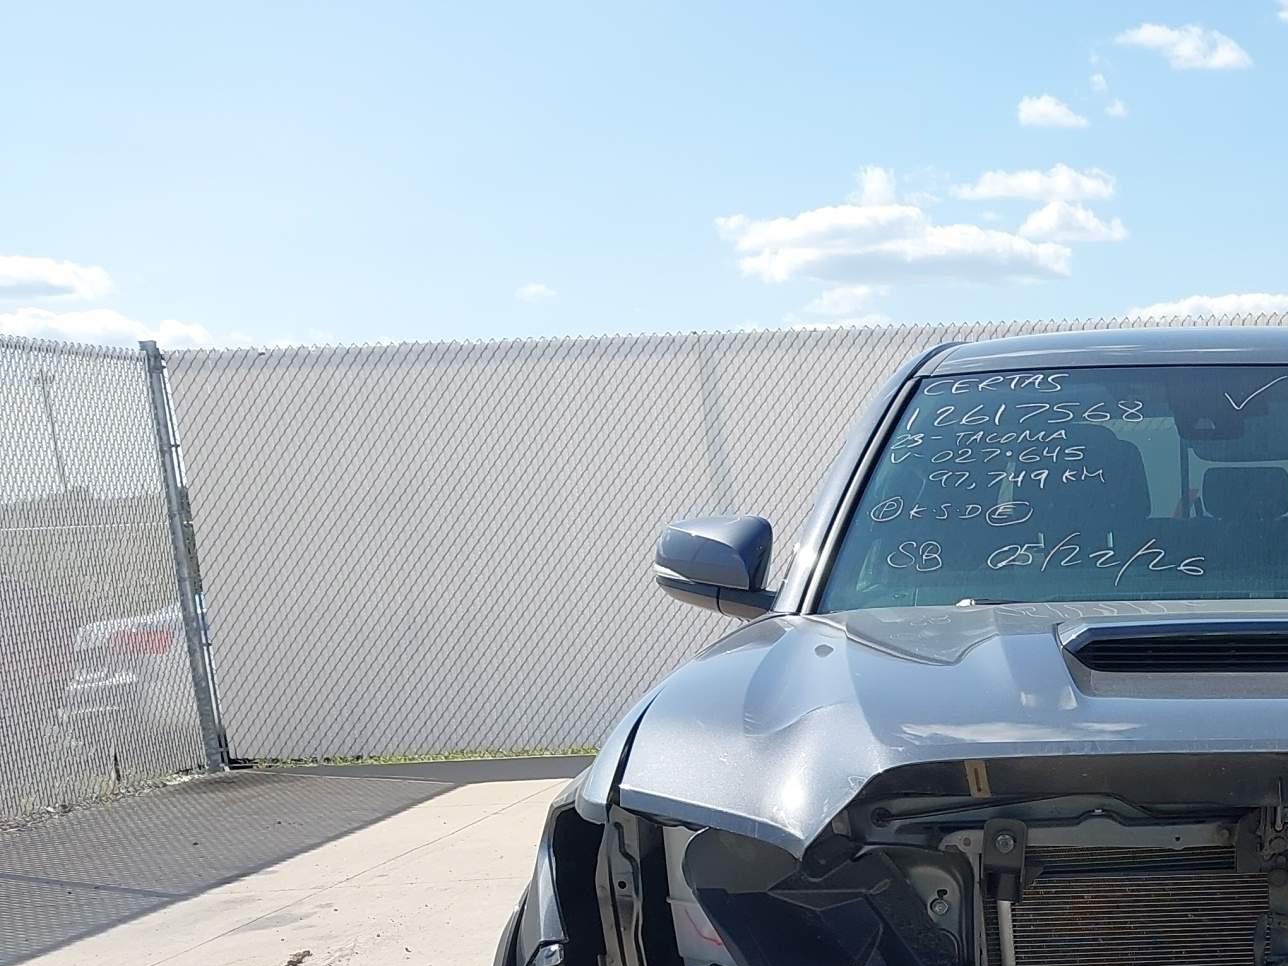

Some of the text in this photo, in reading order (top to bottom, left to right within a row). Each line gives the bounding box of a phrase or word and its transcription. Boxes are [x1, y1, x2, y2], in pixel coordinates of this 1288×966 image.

[923, 373, 1069, 396] CERTAS
[906, 400, 1144, 430] 12617568
[956, 430, 1067, 445] TACOMA
[928, 466, 1105, 489] 97,749 KM
